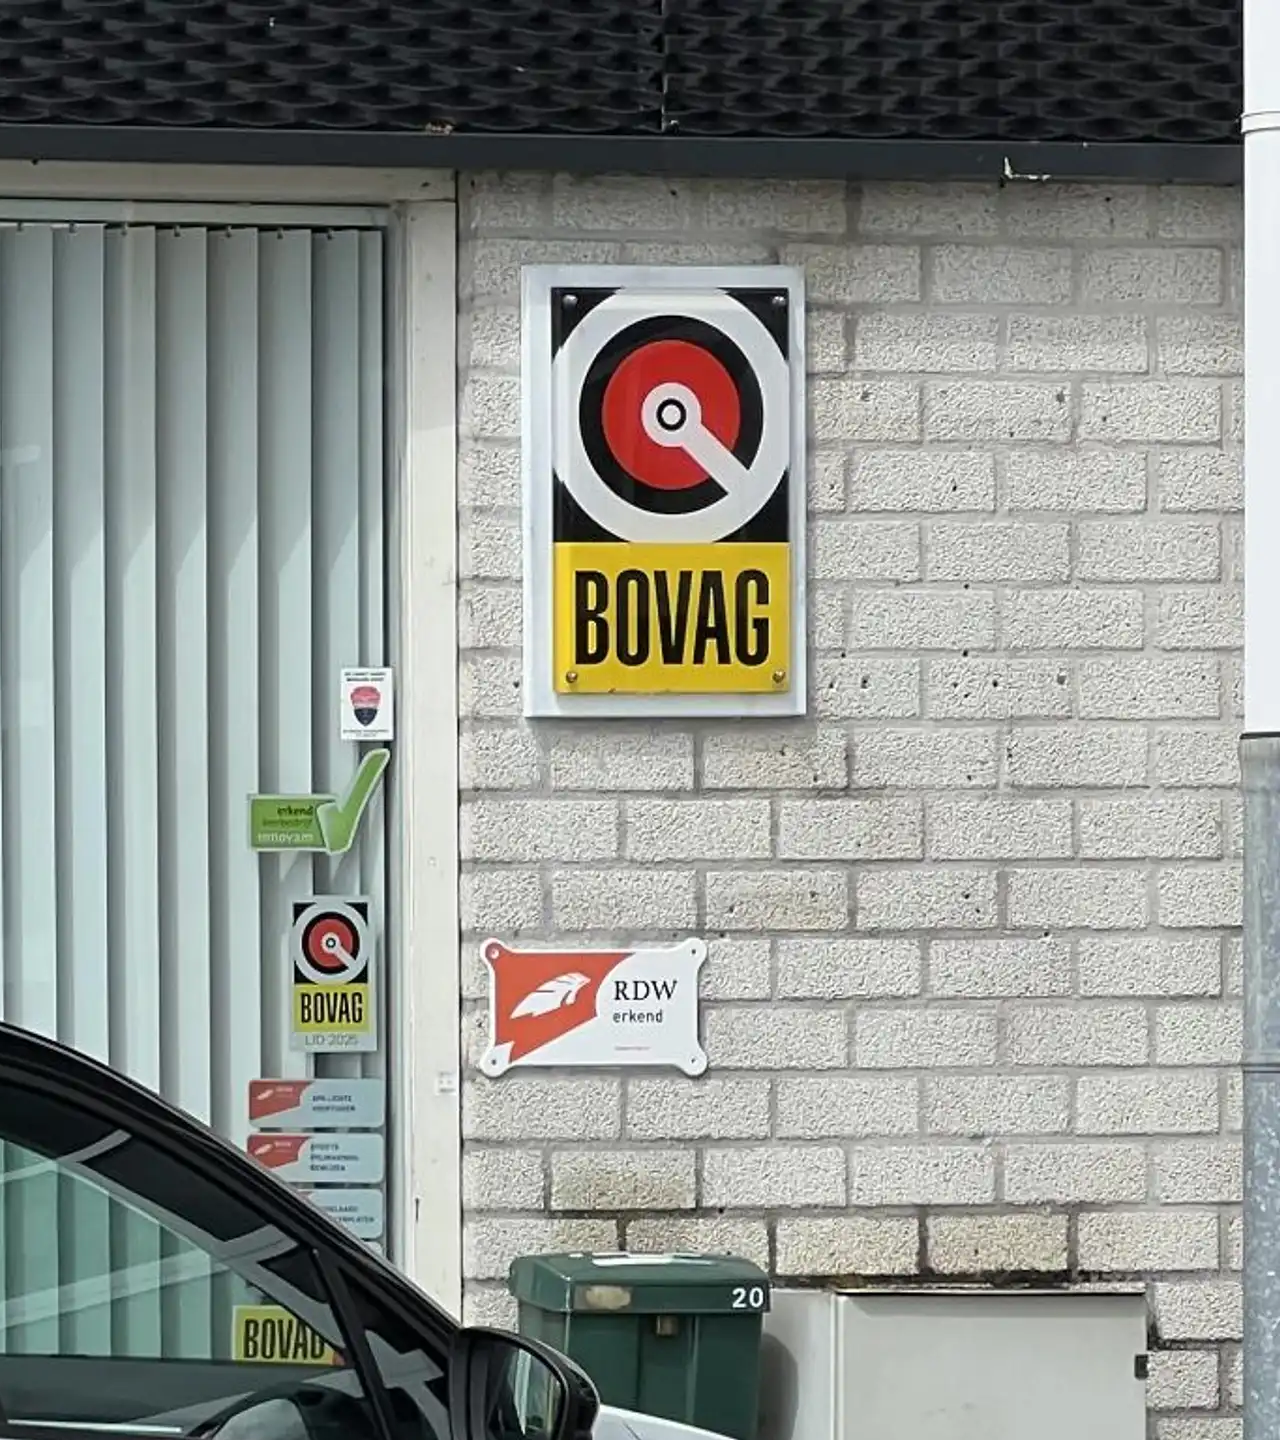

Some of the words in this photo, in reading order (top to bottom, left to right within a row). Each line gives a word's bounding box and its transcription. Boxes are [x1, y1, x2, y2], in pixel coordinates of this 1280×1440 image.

[575, 569, 770, 667] BOVAG
[614, 979, 678, 1000] RDW
[301, 992, 363, 1023] BOVAG
[613, 1009, 663, 1023] erkend
[305, 1035, 325, 1046] LID
[732, 1287, 765, 1309] 20
